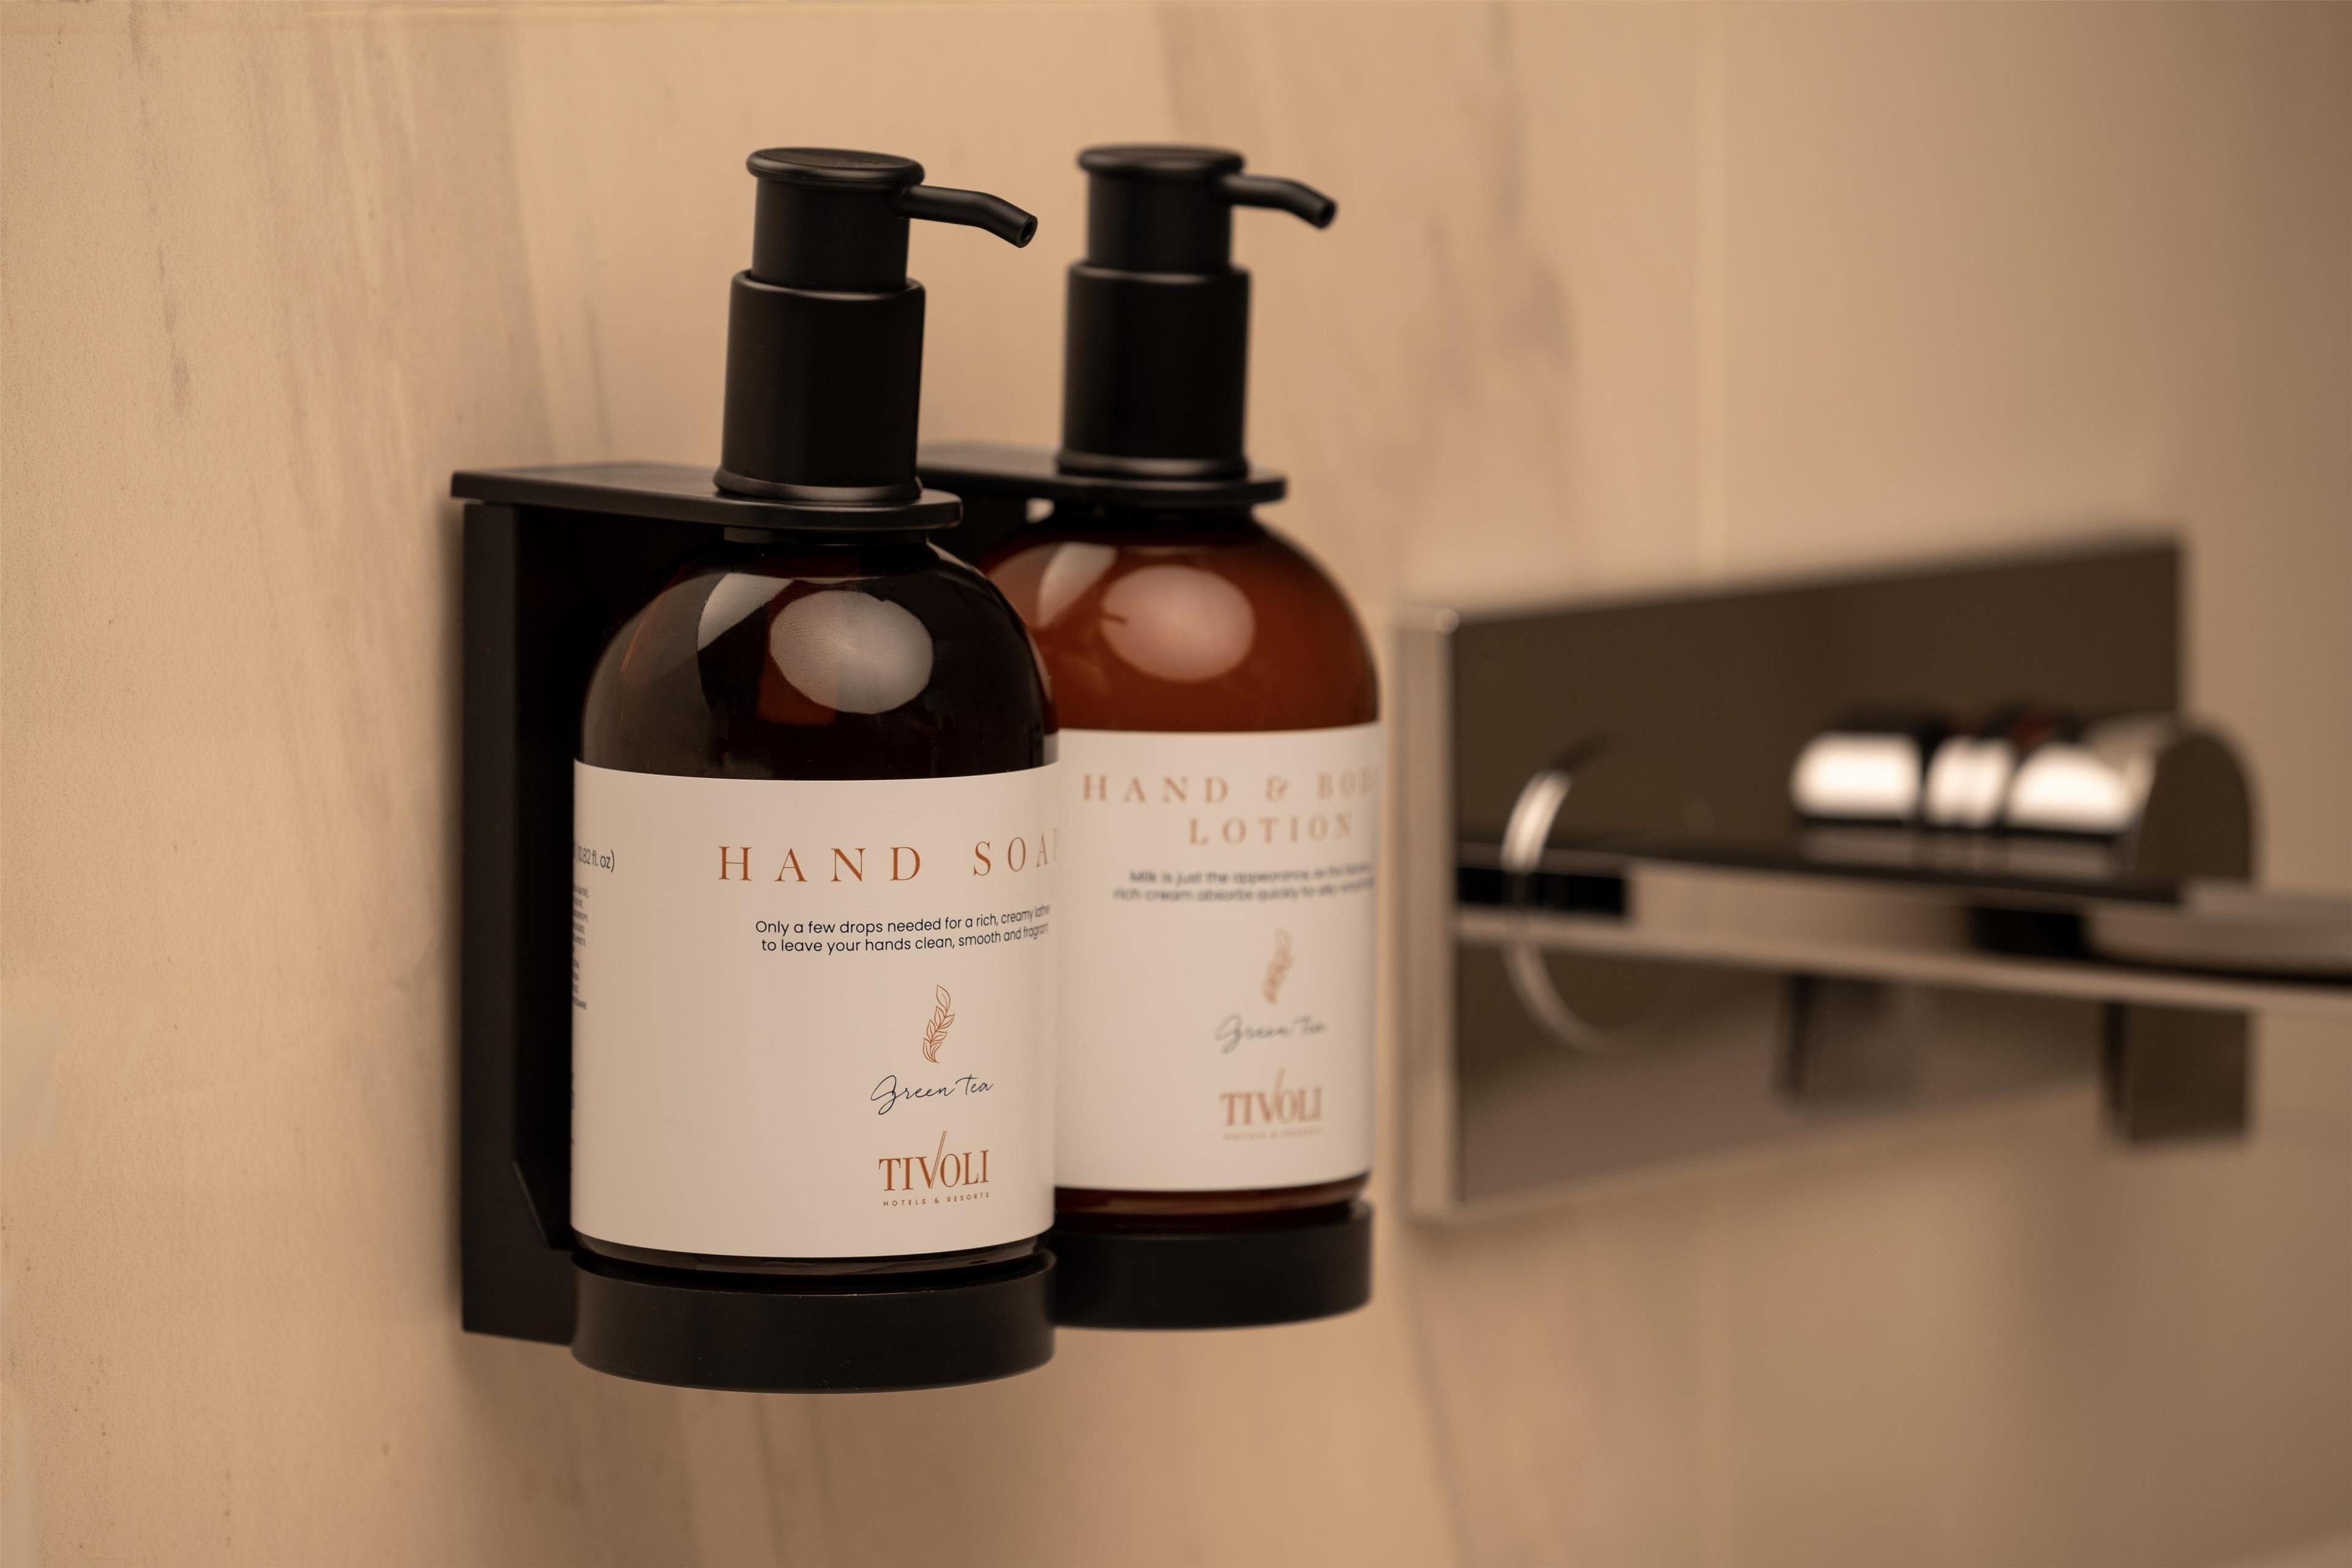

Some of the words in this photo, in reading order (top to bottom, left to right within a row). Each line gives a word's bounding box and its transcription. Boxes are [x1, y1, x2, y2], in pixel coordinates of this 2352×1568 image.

[1082, 774, 1229, 804] HAND
[1264, 775, 1289, 802] &
[1316, 767, 1376, 801] BOD
[1189, 812, 1352, 846] LOTION
[600, 849, 615, 873] oz)
[717, 845, 921, 883] HAND
[755, 921, 790, 937] Only
[793, 924, 804, 933] a
[808, 921, 835, 933] few
[839, 921, 883, 937] drops
[888, 918, 941, 932] needed
[945, 917, 962, 929] for
[965, 918, 973, 928] a
[976, 913, 999, 927] rich,
[1000, 910, 1034, 924] creamy
[761, 939, 777, 951] to
[781, 939, 823, 952] leave
[827, 941, 861, 956] your
[865, 938, 911, 951] hands
[915, 937, 955, 950] clean,
[958, 931, 1001, 946] smooth
[1003, 926, 1021, 941] and
[870, 1074, 957, 1115] Green
[1219, 1067, 1323, 1126] TIVOLI
[878, 1131, 990, 1191] TIVOLI
[883, 1198, 927, 1207] HOTELS
[946, 1192, 990, 1203] RESORTS
